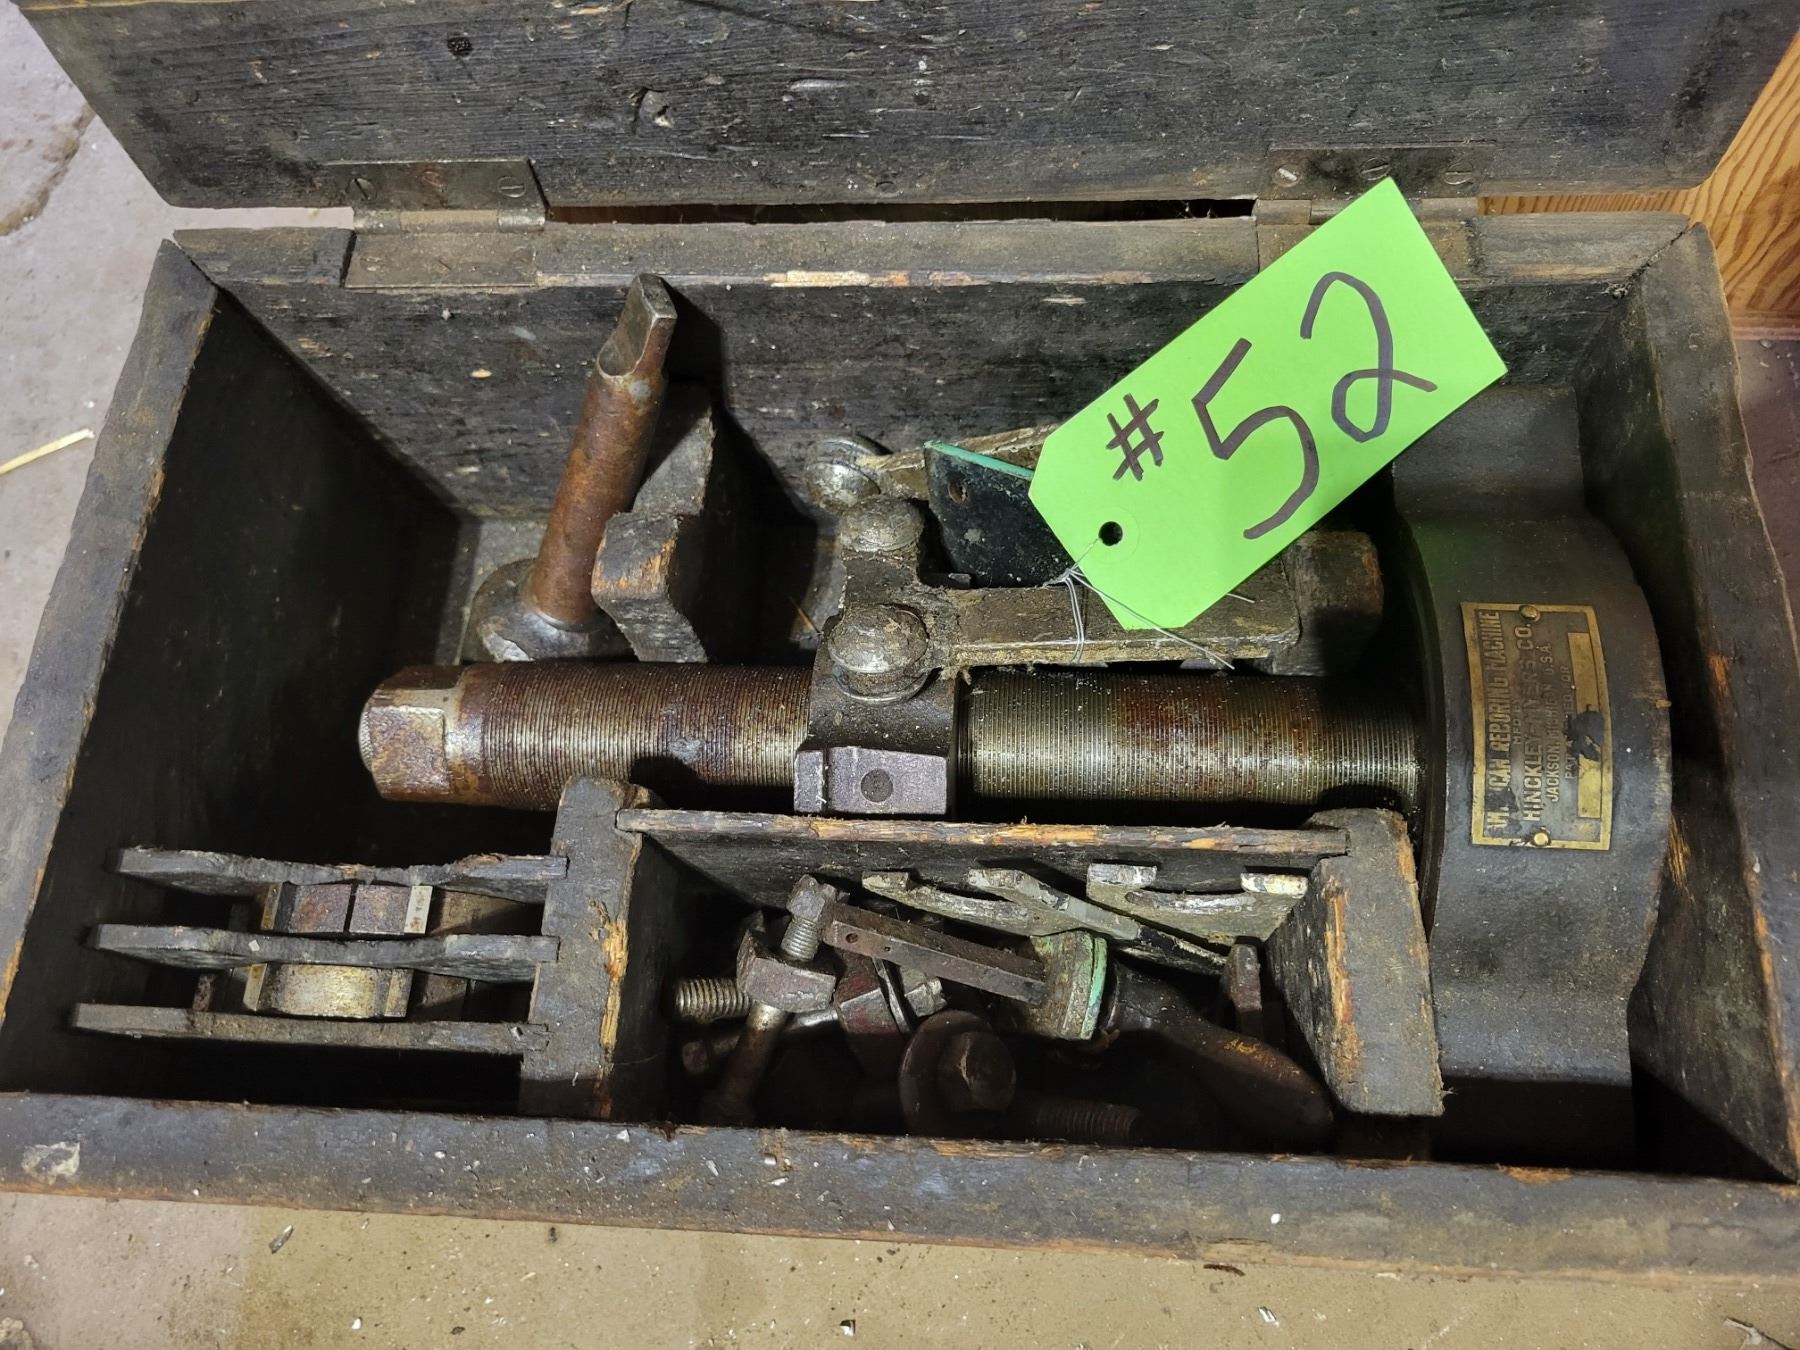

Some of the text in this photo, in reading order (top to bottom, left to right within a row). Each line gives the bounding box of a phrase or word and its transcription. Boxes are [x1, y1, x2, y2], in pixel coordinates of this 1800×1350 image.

[1105, 271, 1438, 540] #52
[1478, 611, 1507, 670] MACHINE
[1487, 677, 1511, 752] REBORING
[1512, 718, 1522, 744] MFD
[1514, 623, 1542, 821] HINCKLEY-MYERS CO.
[1545, 741, 1561, 802] JACKSON,
